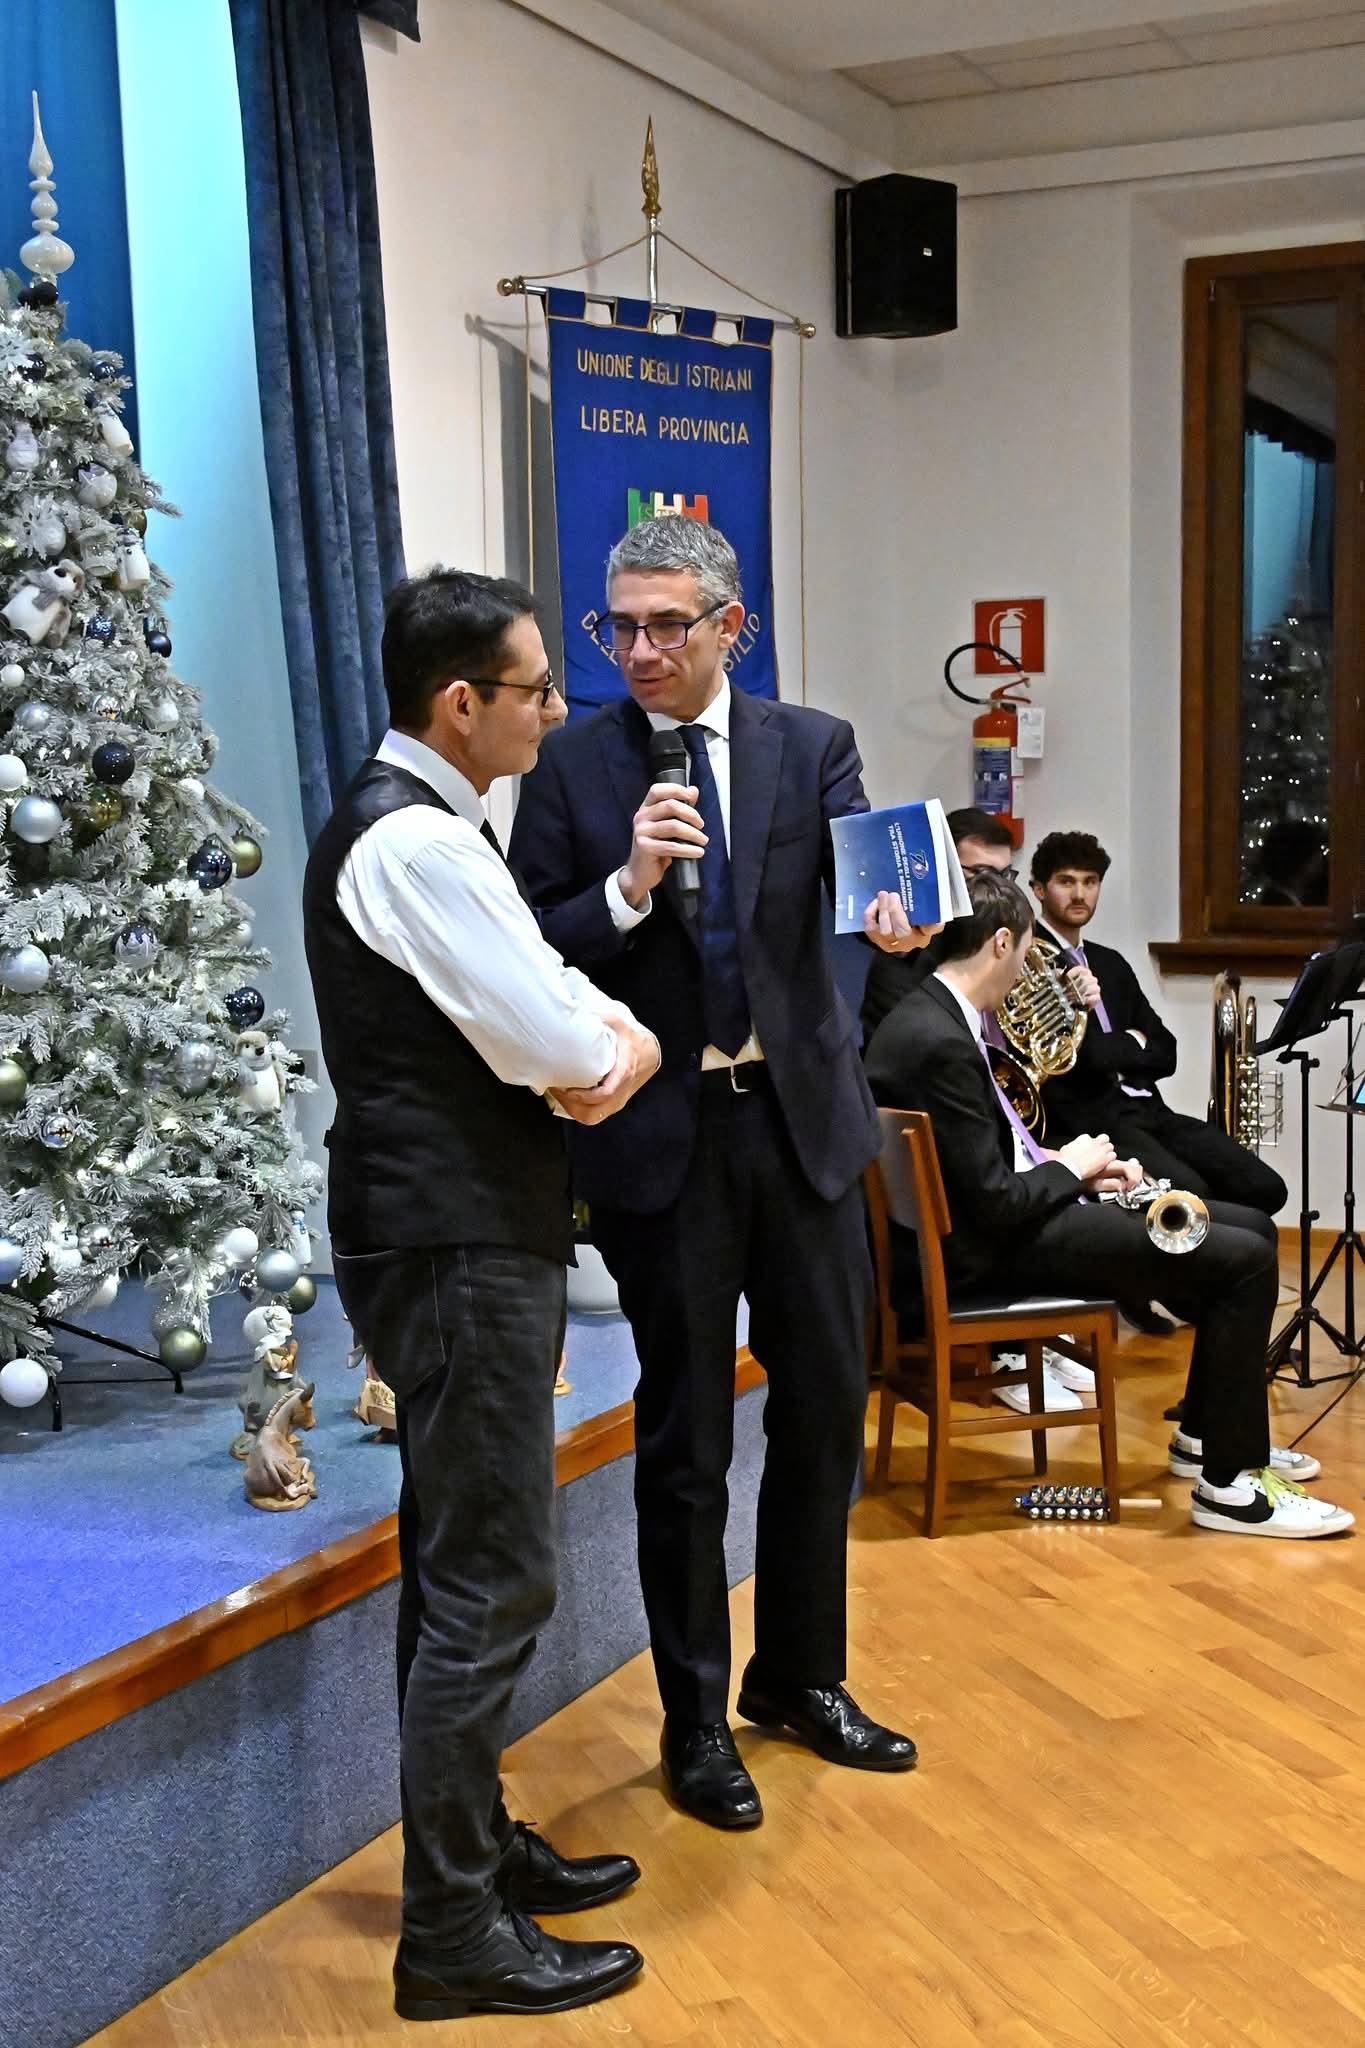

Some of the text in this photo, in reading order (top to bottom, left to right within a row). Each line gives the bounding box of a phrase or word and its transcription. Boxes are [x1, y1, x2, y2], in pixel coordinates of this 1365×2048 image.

[577, 347, 752, 392] UNIONE DEGLI ISTRIANI
[581, 405, 750, 445] LIBERA PROVINCIA
[888, 824, 896, 841] TRA
[891, 840, 902, 869] STORIA
[902, 856, 910, 879] DEGLI
[898, 875, 908, 911] MEMORIA
[905, 879, 914, 912] ISTRIANI
